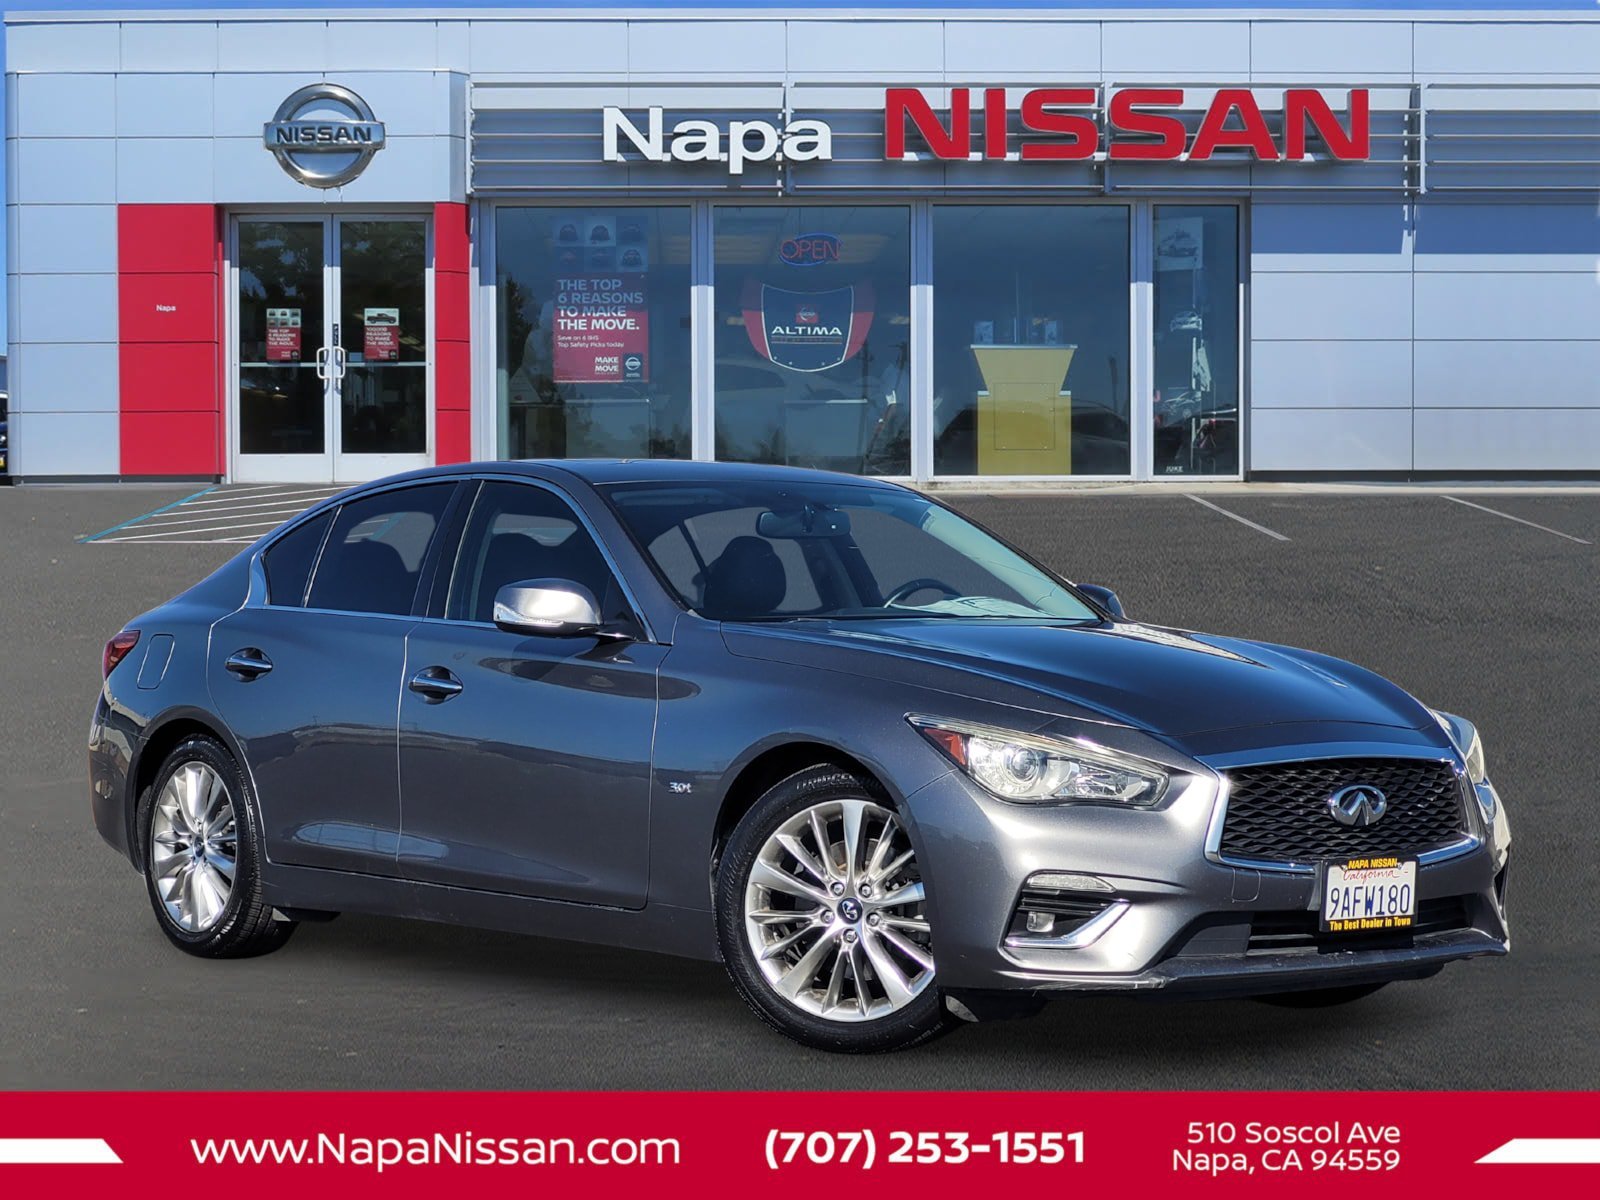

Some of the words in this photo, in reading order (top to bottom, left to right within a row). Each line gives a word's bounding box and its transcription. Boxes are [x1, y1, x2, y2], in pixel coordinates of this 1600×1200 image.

[276, 126, 371, 143] NISSAN
[603, 106, 833, 174] Napa
[885, 88, 1369, 160] NISSAN
[781, 240, 841, 261] OPEN
[558, 279, 587, 291] THE
[591, 279, 622, 291] TOP
[558, 292, 567, 304] 6
[571, 292, 644, 304] REASONS
[156, 304, 176, 312] Napa
[558, 306, 578, 317] TO
[582, 306, 626, 317] MAKE
[558, 319, 587, 330] THE
[591, 319, 640, 330] MOVE.
[772, 326, 842, 335] ALTIMA
[1348, 859, 1369, 869] NAPA
[1370, 858, 1398, 868] NISSAN
[1343, 869, 1400, 884] California
[1329, 884, 1410, 918] 9AFW180
[1330, 921, 1342, 931] The
[1344, 920, 1359, 930] Best
[1361, 918, 1384, 929] Dealer
[1385, 918, 1392, 927] in
[1393, 917, 1411, 926] Town
